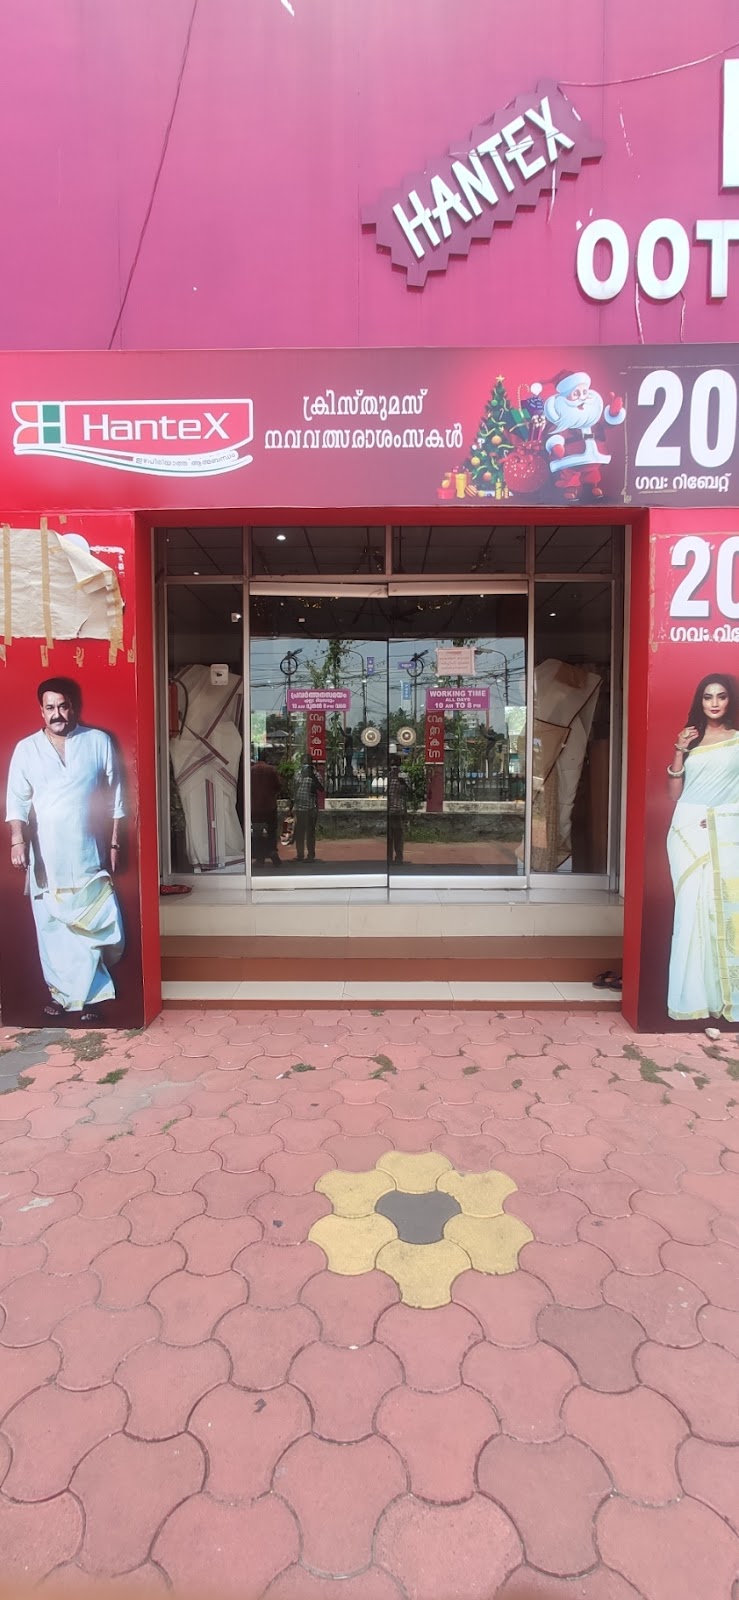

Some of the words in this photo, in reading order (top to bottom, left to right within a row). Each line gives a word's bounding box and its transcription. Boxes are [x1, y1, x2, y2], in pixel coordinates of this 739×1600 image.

[392, 95, 575, 259] HANTEX
[302, 388, 428, 421] ക്രിസ്തുമസ്
[635, 368, 738, 468] 20
[82, 411, 230, 441] HanteX
[264, 422, 464, 449] നവവത്സരാശംസകൾ
[672, 472, 732, 493] റിബേറ്റ്
